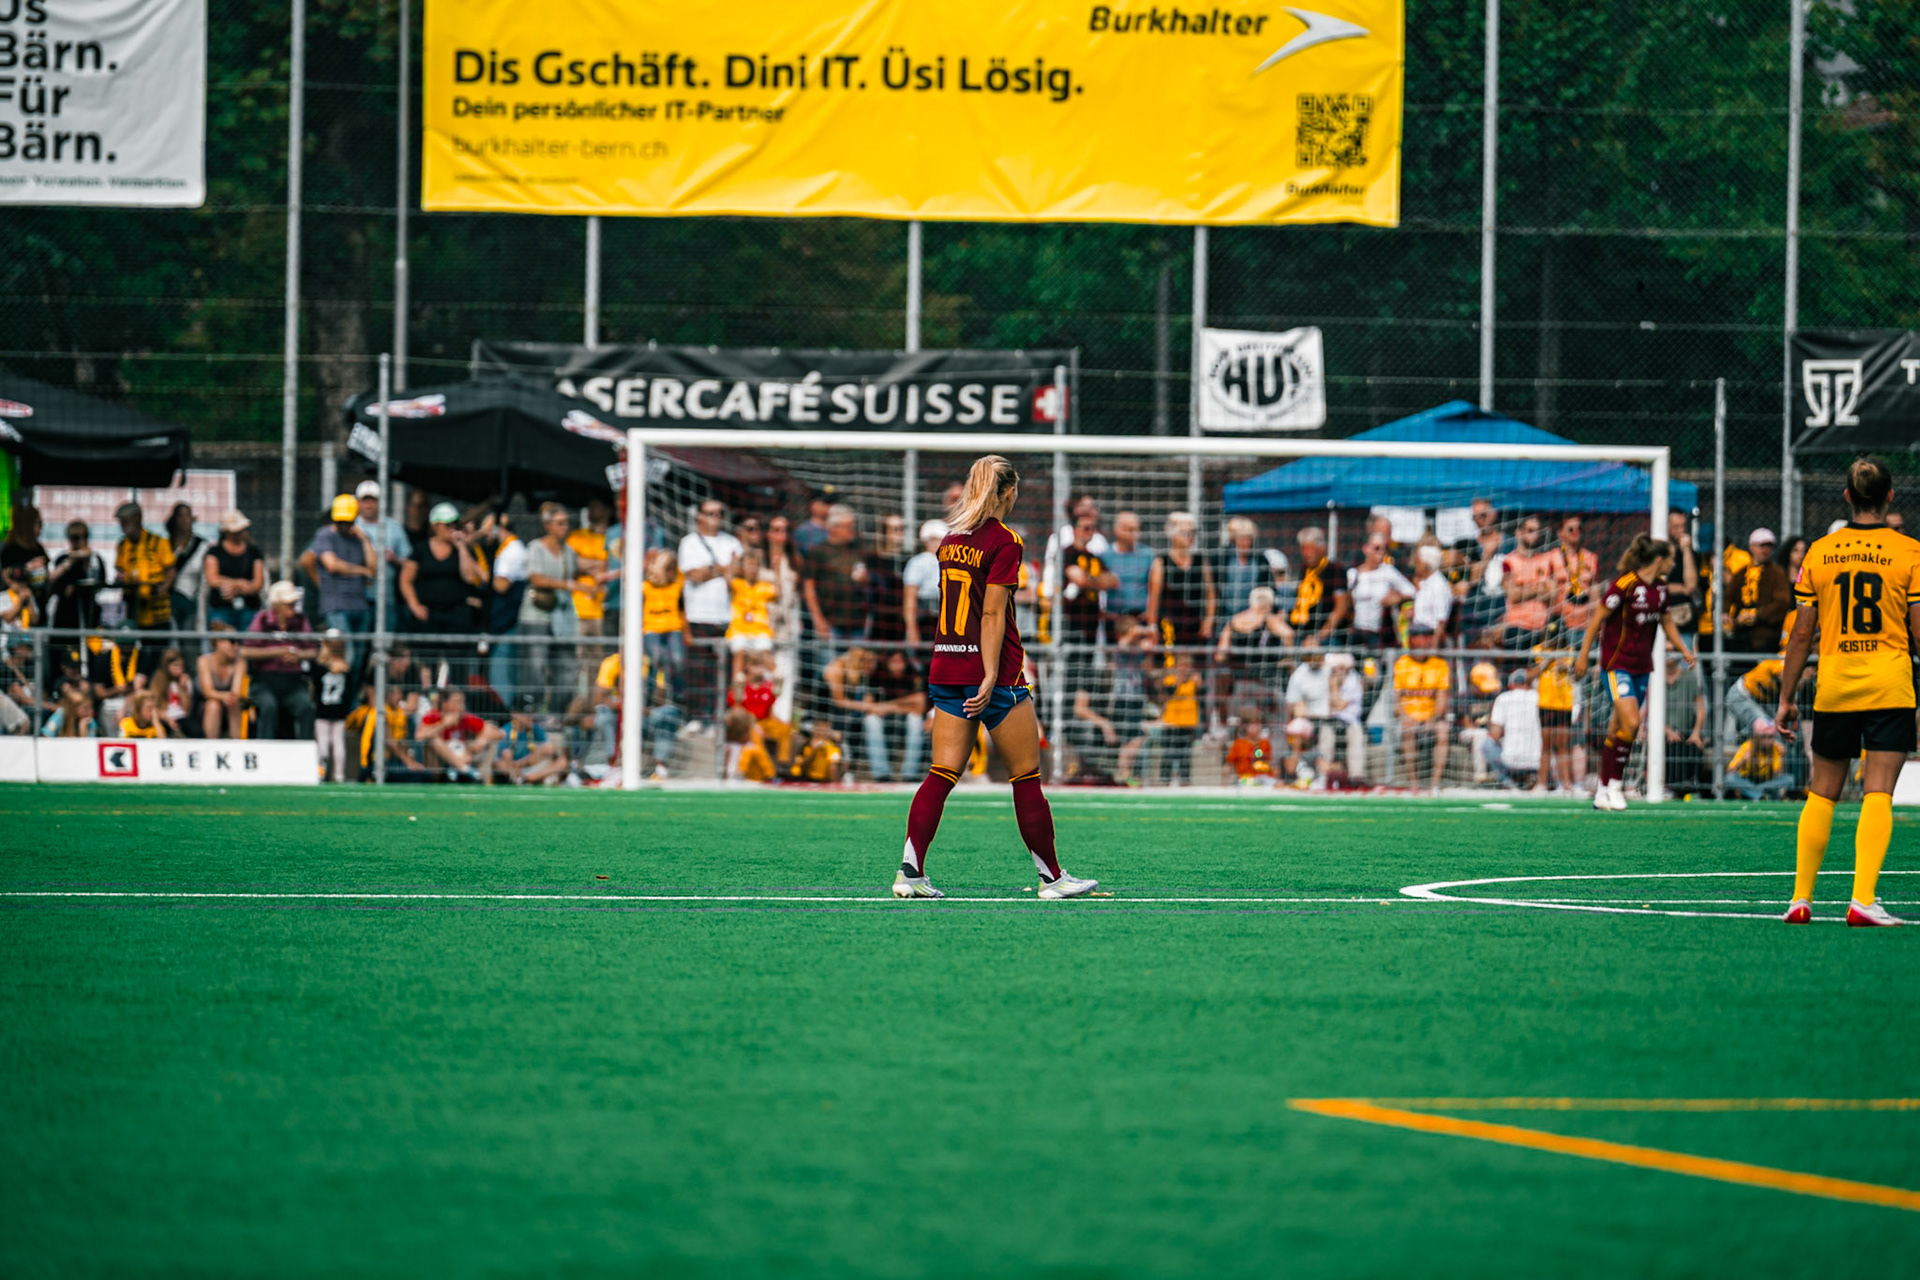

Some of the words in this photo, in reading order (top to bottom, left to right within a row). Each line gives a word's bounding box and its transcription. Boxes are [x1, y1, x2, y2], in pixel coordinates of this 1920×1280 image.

[1088, 6, 1269, 35] Burkhalter
[0, 30, 118, 71] Bärn.
[454, 50, 520, 85] Dis
[532, 51, 710, 88] Gschäft.
[725, 54, 808, 90] Dini
[822, 55, 867, 90] IT.
[882, 47, 946, 90] Üsi
[959, 57, 1085, 102] Lösig.
[0, 76, 71, 116] Für
[453, 96, 507, 118] Dein
[513, 98, 658, 122] persönlicher
[666, 101, 785, 122] IT-Partner
[0, 121, 117, 162] Bärn.
[829, 383, 1021, 425] SUISSE
[1823, 552, 1893, 566] Intermakler
[940, 568, 972, 636] 17
[1834, 571, 1883, 635] 18
[1838, 640, 1878, 652] MEISTER
